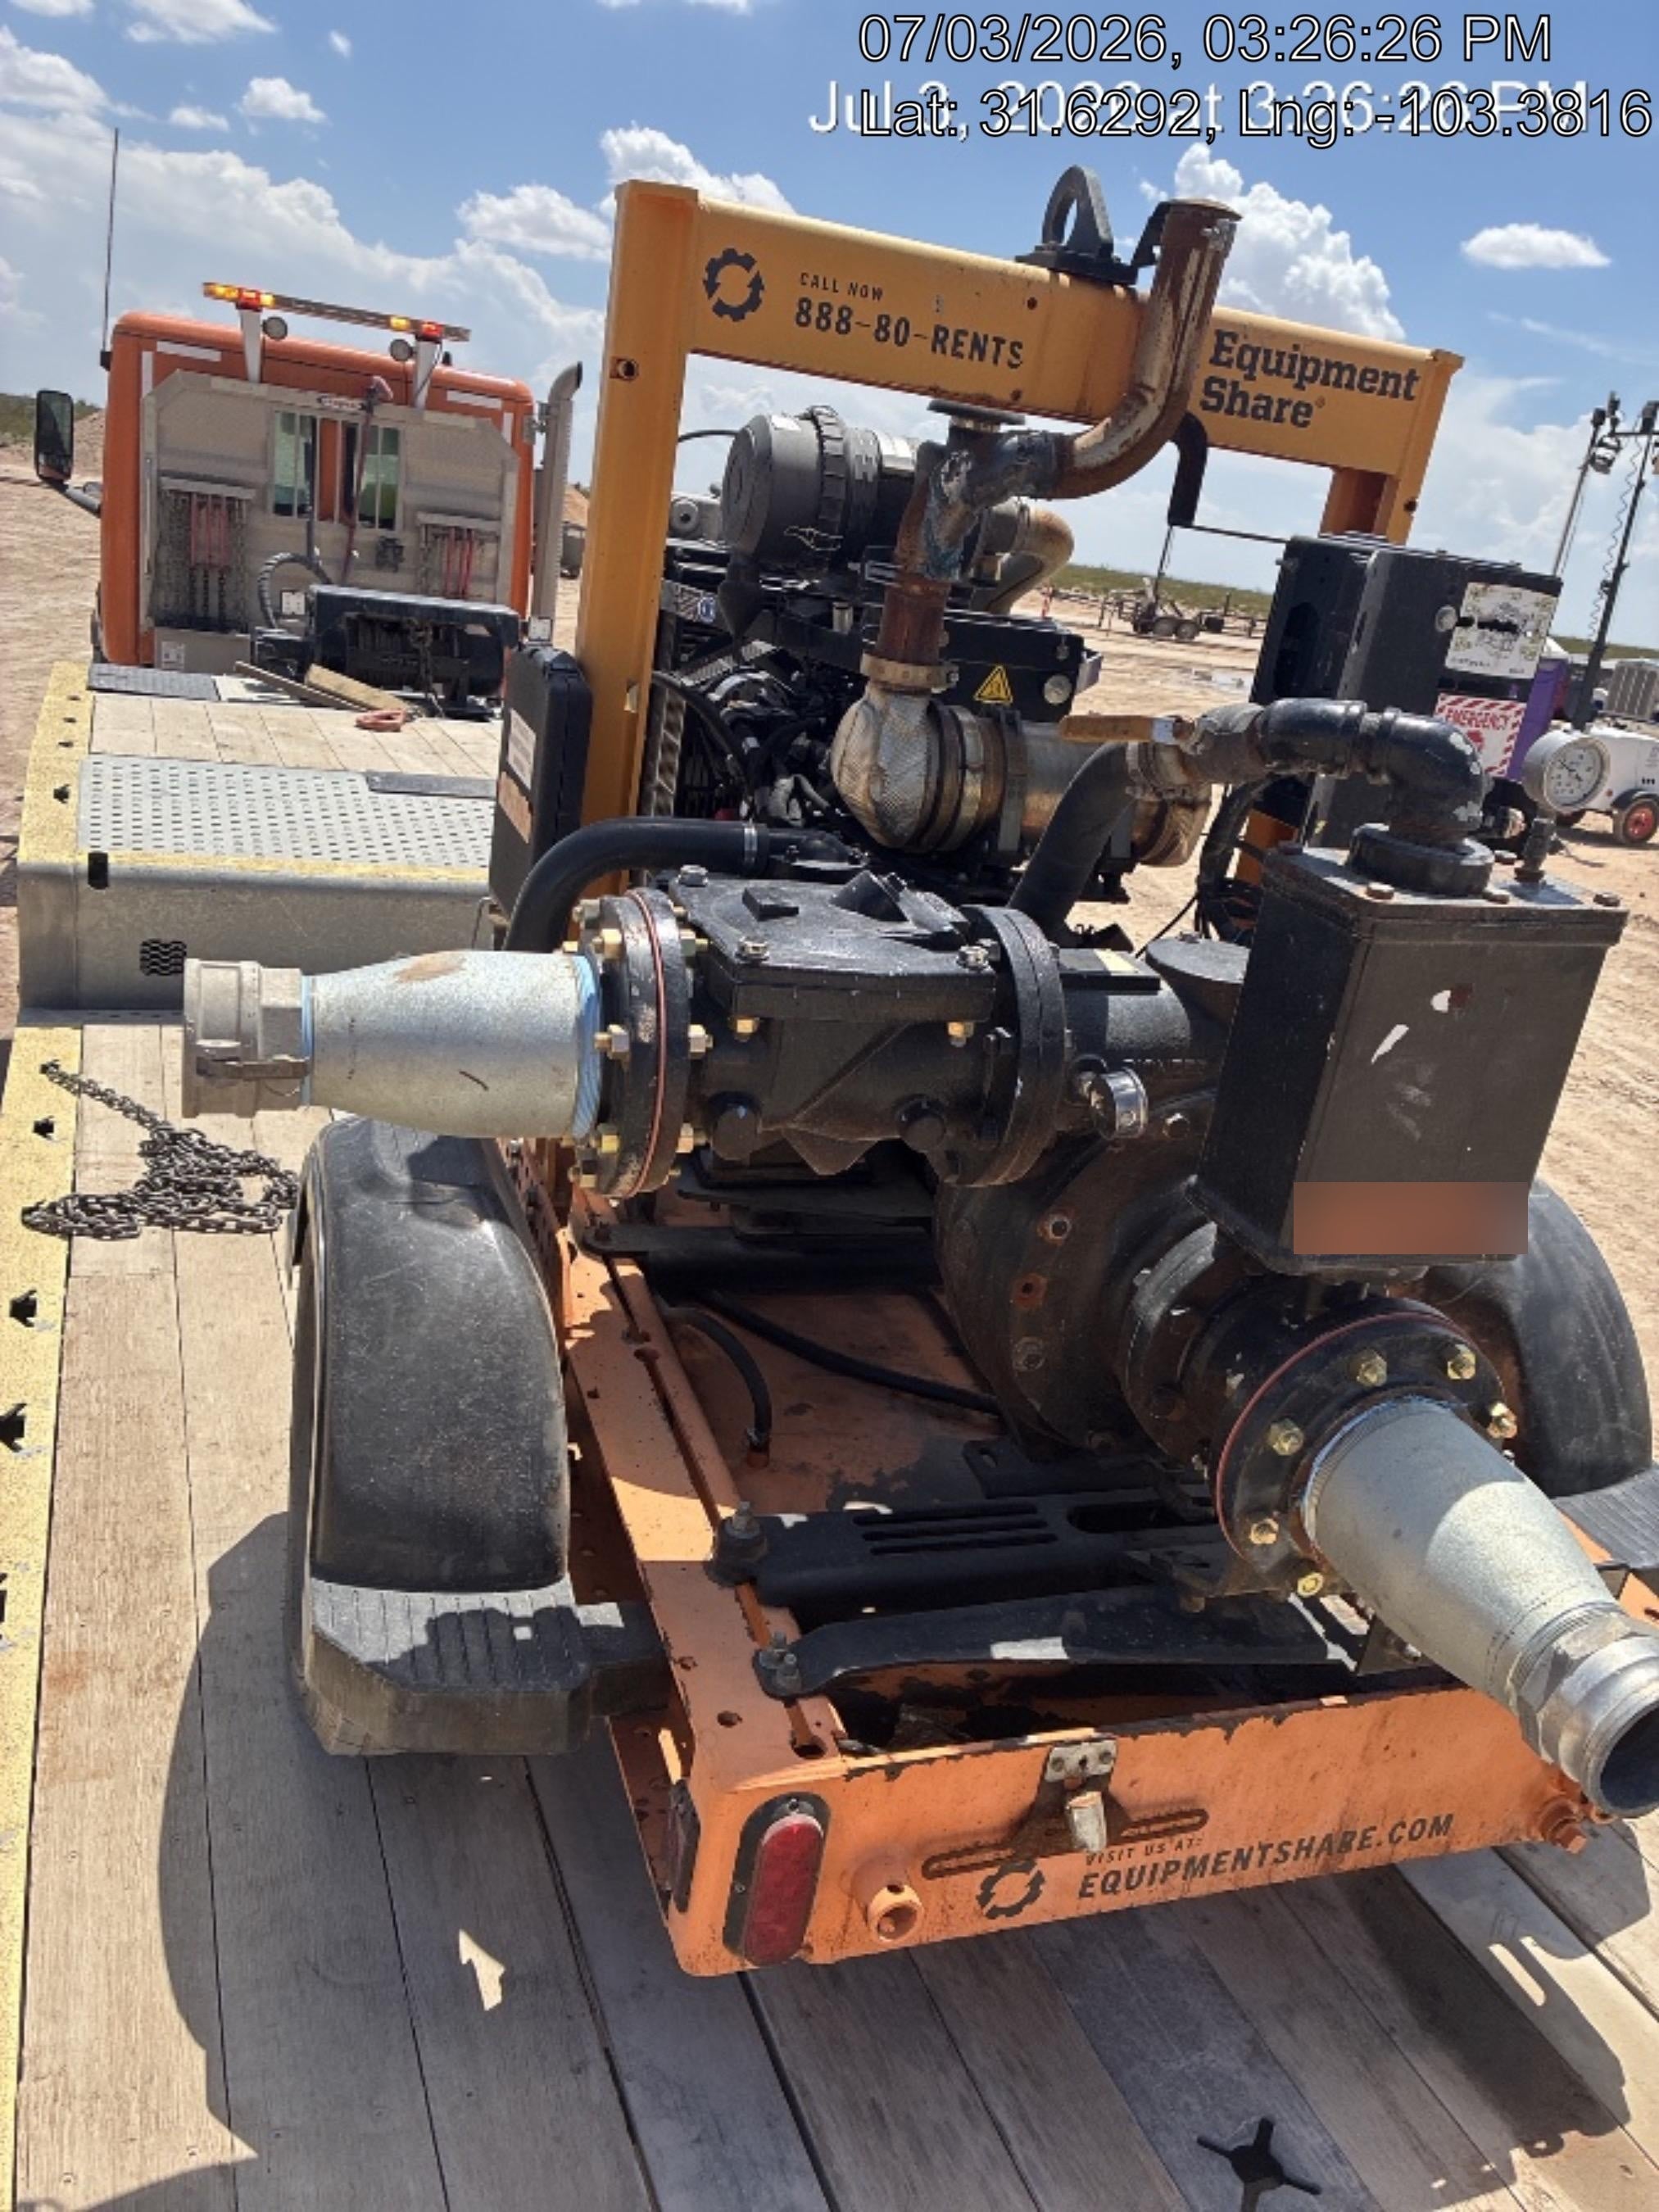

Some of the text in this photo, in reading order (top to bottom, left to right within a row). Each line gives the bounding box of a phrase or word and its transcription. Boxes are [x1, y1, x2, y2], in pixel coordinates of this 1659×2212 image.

[800, 272, 883, 301] CALL NOW
[795, 297, 1023, 369] 888-80-RENTS
[1208, 329, 1421, 401] Equipment
[1086, 1838, 1203, 1866] VISIT US AT:
